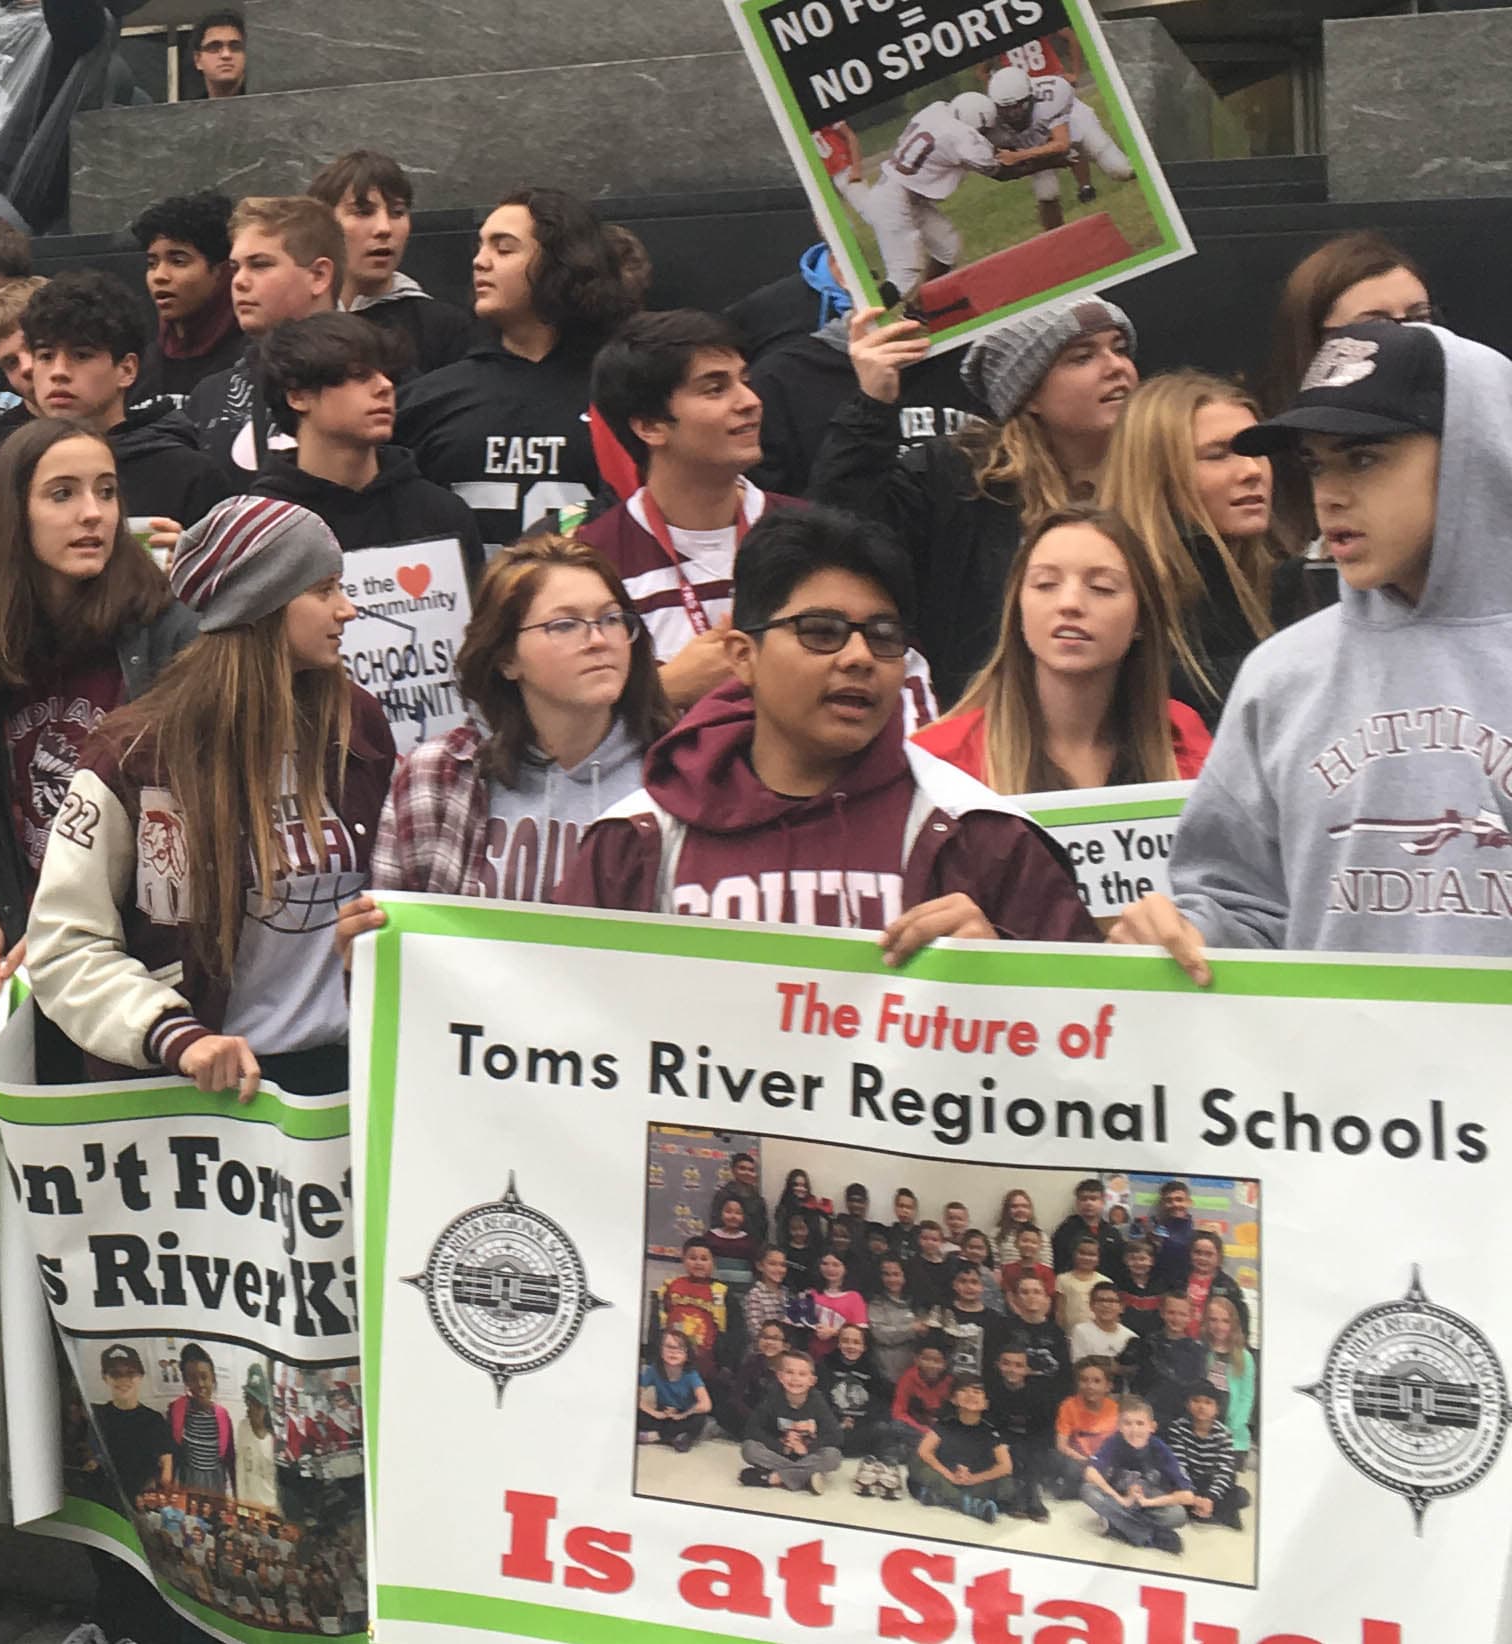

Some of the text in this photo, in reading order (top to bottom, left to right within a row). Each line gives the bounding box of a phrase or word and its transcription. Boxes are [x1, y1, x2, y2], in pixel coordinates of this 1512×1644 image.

[771, 1, 834, 52] NO
[809, 0, 1043, 109] NO SPORTS
[484, 436, 567, 475] EAST
[354, 590, 458, 620] ommunity
[362, 575, 395, 596] the
[55, 791, 101, 850] 22
[1100, 870, 1155, 905] the
[777, 981, 1116, 1060] The Future of
[449, 1022, 1489, 1164] Toms River Regional Schools
[88, 1231, 285, 1328] River
[501, 1489, 636, 1595] Is
[677, 1538, 837, 1629] at
